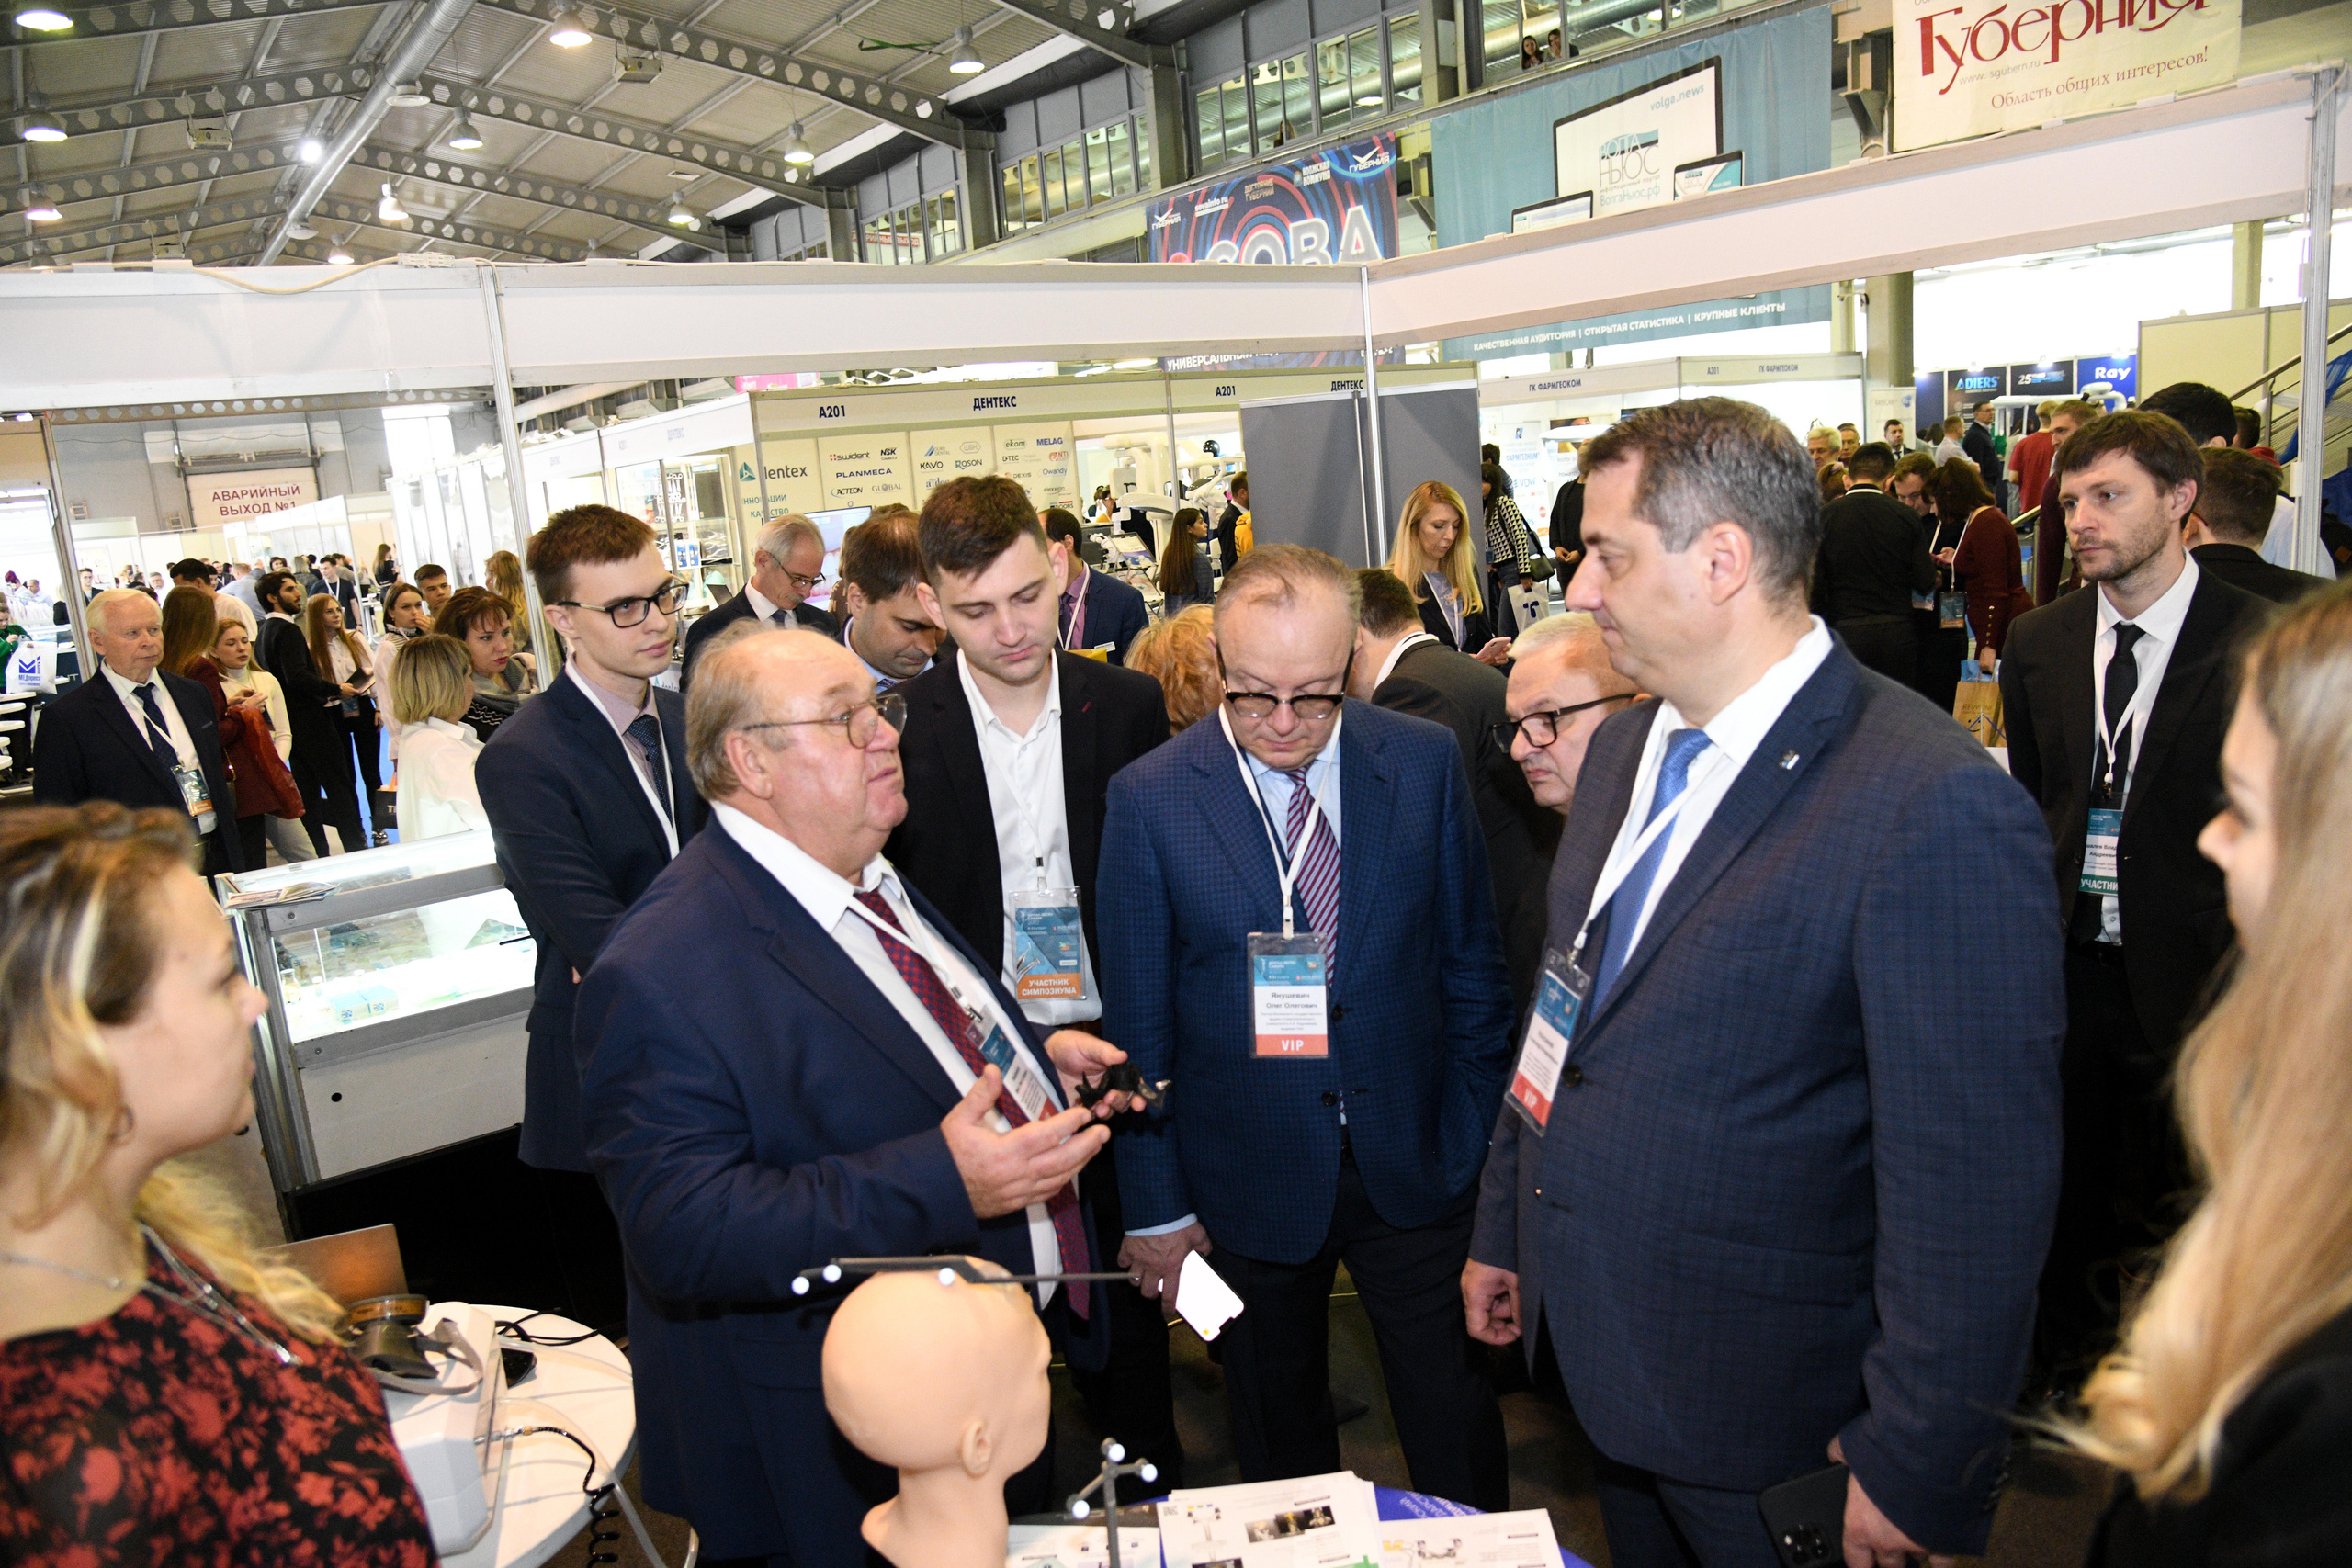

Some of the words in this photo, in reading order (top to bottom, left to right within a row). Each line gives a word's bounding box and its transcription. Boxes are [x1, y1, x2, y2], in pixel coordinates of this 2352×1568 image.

[1991, 88, 2052, 109] Область
[2055, 74, 2110, 95] общих
[2116, 46, 2209, 83] интересов!
[1650, 84, 1705, 111] volga.news
[1349, 155, 1390, 173] ГУБЕРНИЯ
[1600, 183, 1660, 206] ВолгаНьюс.рф
[1474, 336, 1529, 351] КАЧЕСТВЕННАЯ
[1530, 330, 1576, 344] АУДИТОРИЯ
[1584, 321, 1628, 336] ОТКРЫТАЯ
[1629, 315, 1684, 331] СТАТИСТИКА
[1694, 308, 1738, 321] КРУПНЫЕ
[1740, 302, 1786, 316] КЛИЕНТЫ
[2095, 367, 2131, 380] Ray
[1330, 380, 1363, 392] ДЕНТЕКС
[1529, 384, 1536, 392] ГК
[1538, 378, 1581, 390] ФАРМГЕОКОМ
[2018, 375, 2032, 385] 25
[973, 396, 1017, 411] ДЕНТЕКС
[1005, 440, 1025, 448] ekom
[1036, 437, 1063, 446] MELAG
[836, 468, 892, 479] PLANMECA
[1043, 468, 1067, 476] Owandy
[212, 484, 300, 502] АВАРИЙНЫЙ
[836, 487, 863, 495] ACTEON
[872, 483, 902, 492] GLOBAL
[742, 494, 787, 505] ННОАЦИИ
[220, 503, 272, 516] ВЫХОД
[750, 508, 789, 518] КАСТВО
[2080, 879, 2118, 891] УЧАСТНИ
[1022, 987, 1077, 997] СИМПОЗИУМА
[1282, 1040, 1304, 1051] VIP
[1524, 1088, 1538, 1110] VIP
